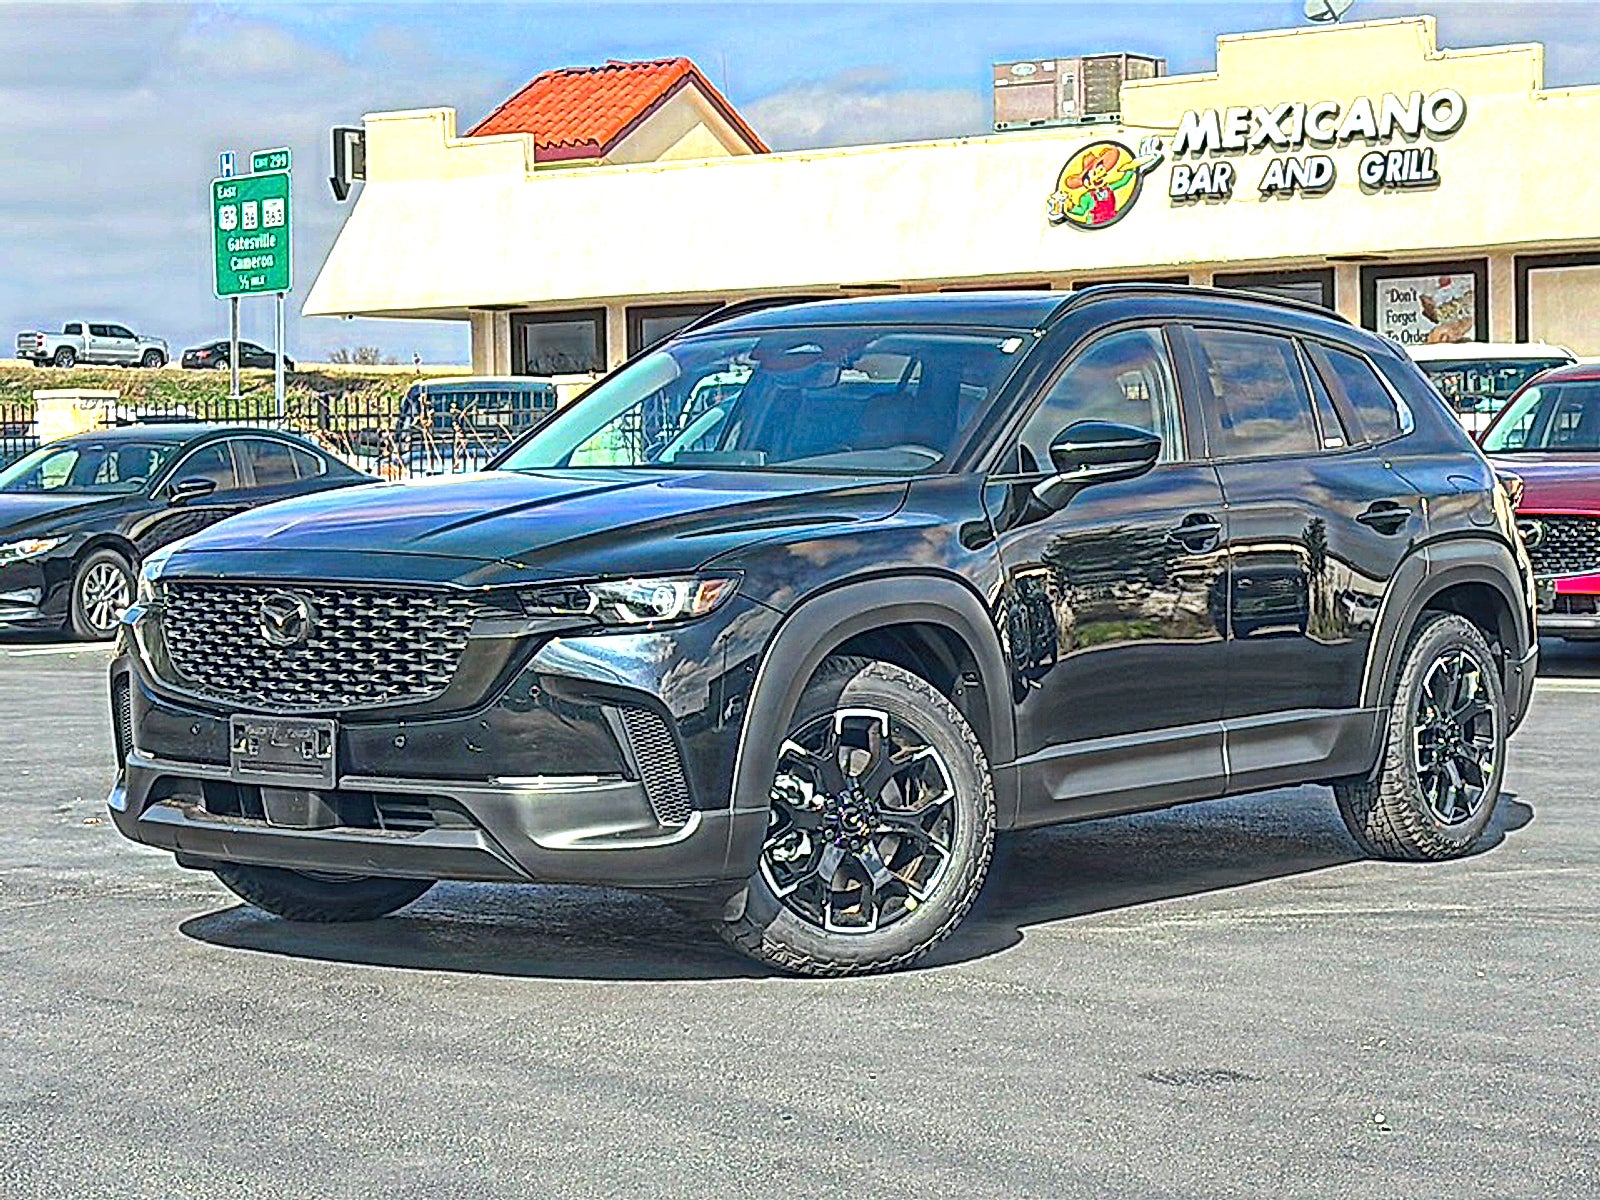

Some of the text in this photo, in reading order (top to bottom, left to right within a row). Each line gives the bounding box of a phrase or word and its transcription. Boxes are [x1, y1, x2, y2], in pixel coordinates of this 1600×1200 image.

[1172, 88, 1466, 157] MEXICANO
[1170, 147, 1440, 201] BAR AND GRILL
[227, 232, 276, 252] Gatesville
[230, 254, 274, 271] Cameron
[1386, 309, 1417, 326] Forget
[1400, 328, 1430, 344] Order
